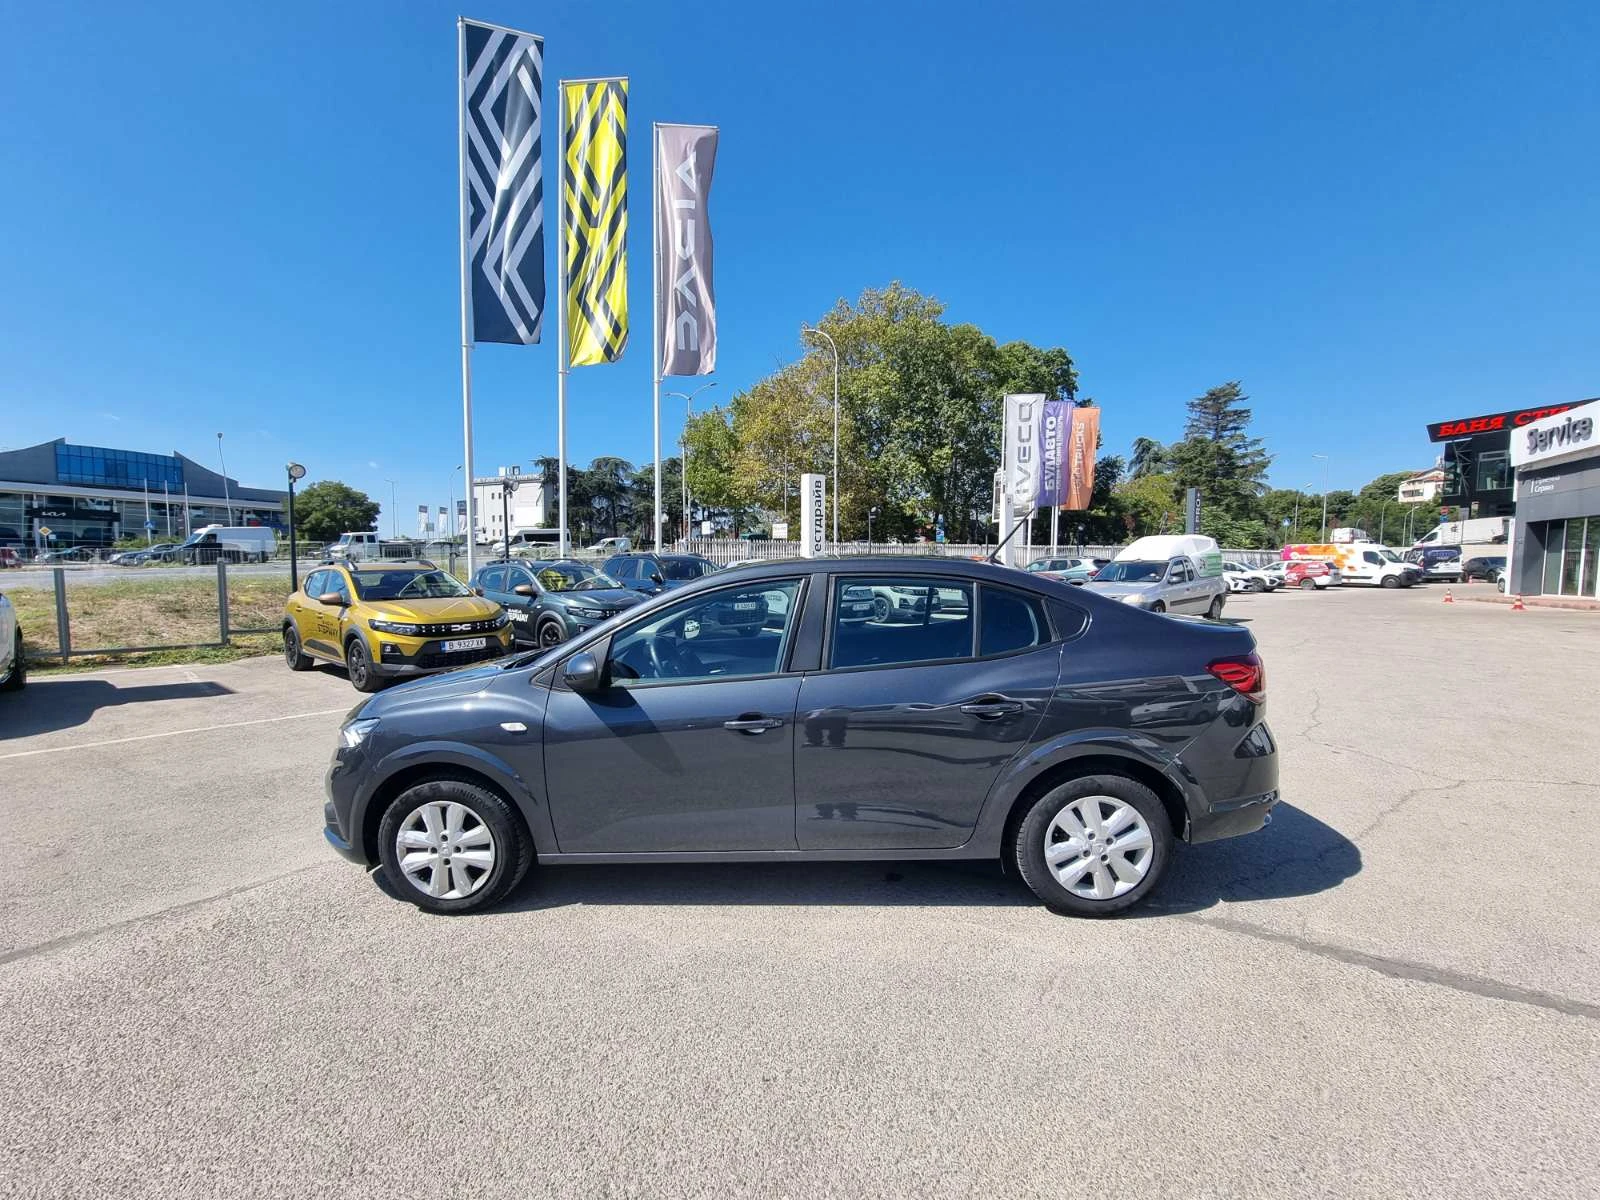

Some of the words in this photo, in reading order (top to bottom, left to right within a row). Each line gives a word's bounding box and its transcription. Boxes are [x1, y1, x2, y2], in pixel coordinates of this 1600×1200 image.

[673, 151, 698, 350] DACIA
[1016, 402, 1033, 495] IVECO
[1045, 416, 1057, 491] БУЛАВТО
[1438, 415, 1506, 437] БАНЯ
[1527, 416, 1593, 454] Service
[813, 480, 823, 556] естдрайв
